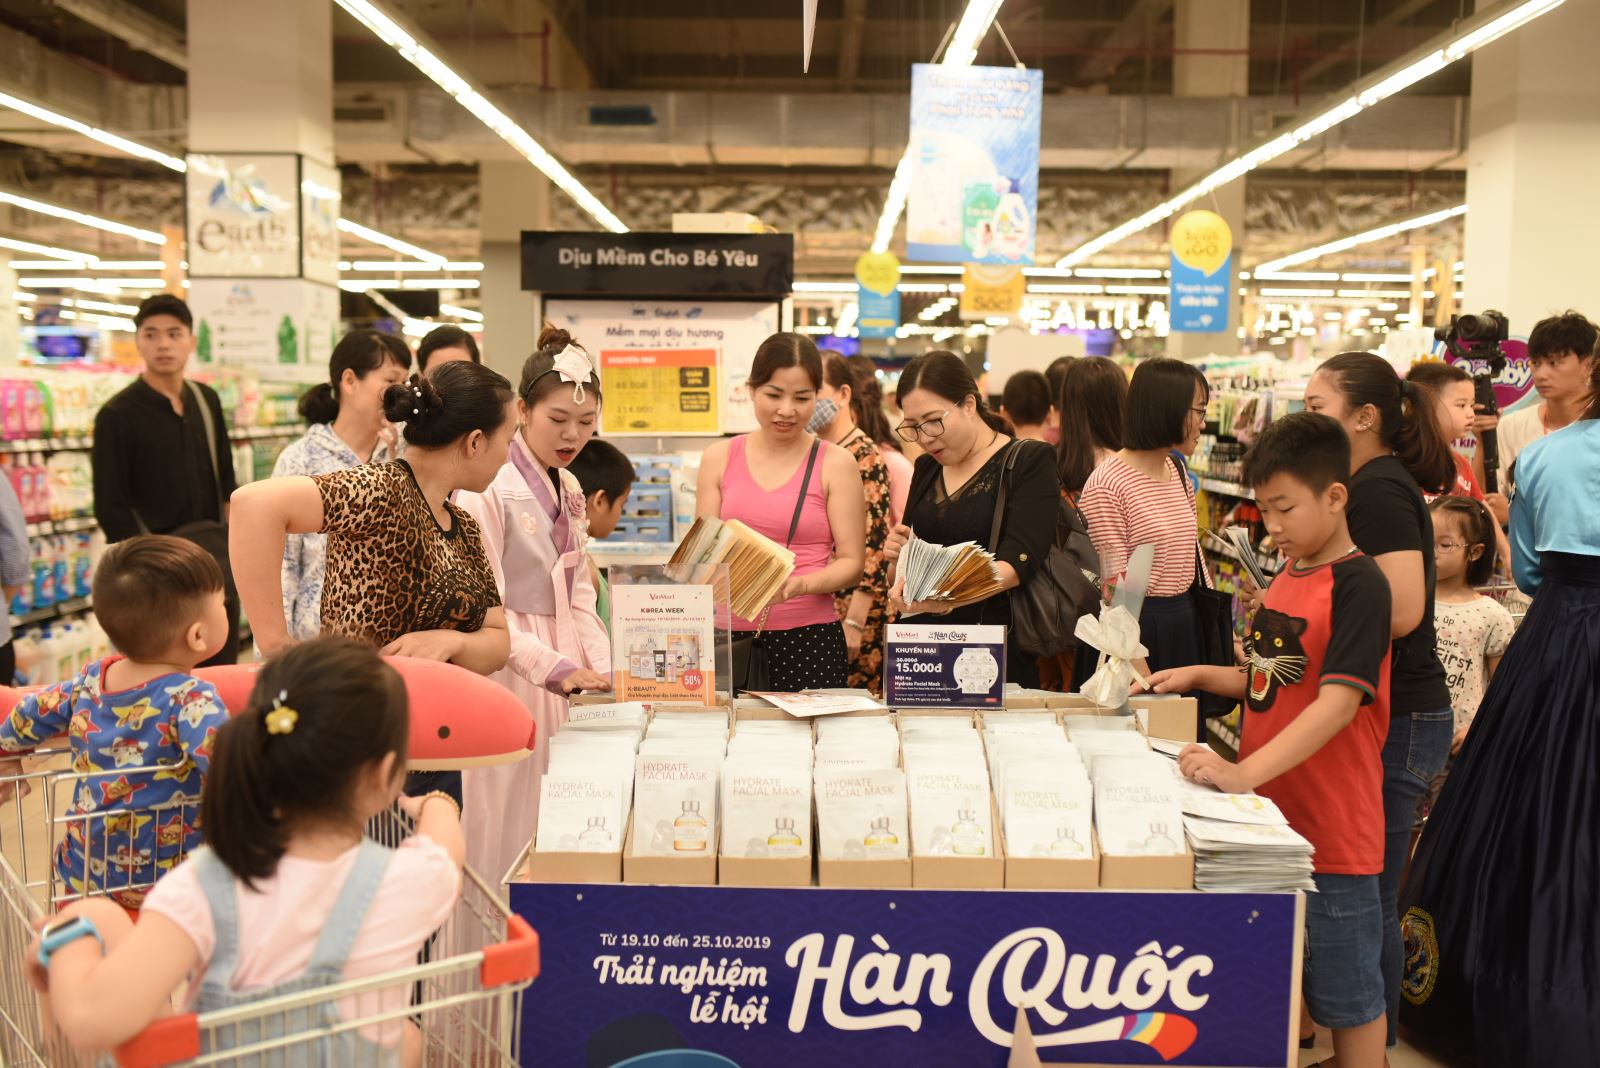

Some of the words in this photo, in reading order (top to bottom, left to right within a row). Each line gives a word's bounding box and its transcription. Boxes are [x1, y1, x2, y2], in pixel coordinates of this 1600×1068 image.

[558, 247, 592, 269] Dịu
[596, 246, 646, 266] Mềm
[649, 248, 690, 267] Cho
[693, 248, 719, 267] Bé
[722, 248, 759, 267] Yêu
[1438, 635, 1460, 648] have
[895, 646, 922, 654] KHUYẾN
[923, 647, 937, 655] MẠI
[896, 662, 943, 673] 15.000đ
[684, 675, 701, 685] 50%
[643, 762, 689, 772] HYDRATE
[643, 771, 677, 781] FACIAL
[679, 770, 709, 781] MASK
[733, 776, 784, 786] HYDRATE
[549, 782, 594, 792] HYDRATE
[825, 778, 873, 790] HYDRATE
[548, 790, 585, 800] FACIAL
[585, 790, 616, 800] MASK
[733, 785, 770, 796] FACIAL
[772, 786, 803, 797] MASK
[825, 787, 864, 798] FACIAL
[864, 784, 896, 797] MASK
[600, 933, 617, 947] Từ
[621, 934, 660, 947] 19.10
[663, 933, 689, 948] đến
[692, 935, 771, 949] 25.10.2019
[593, 954, 655, 985] Trải
[659, 956, 768, 994] nghiệm
[784, 932, 953, 1034] Hàn
[967, 926, 1213, 1048] Quốc
[690, 990, 721, 1024] lễ
[721, 995, 769, 1031] hội
